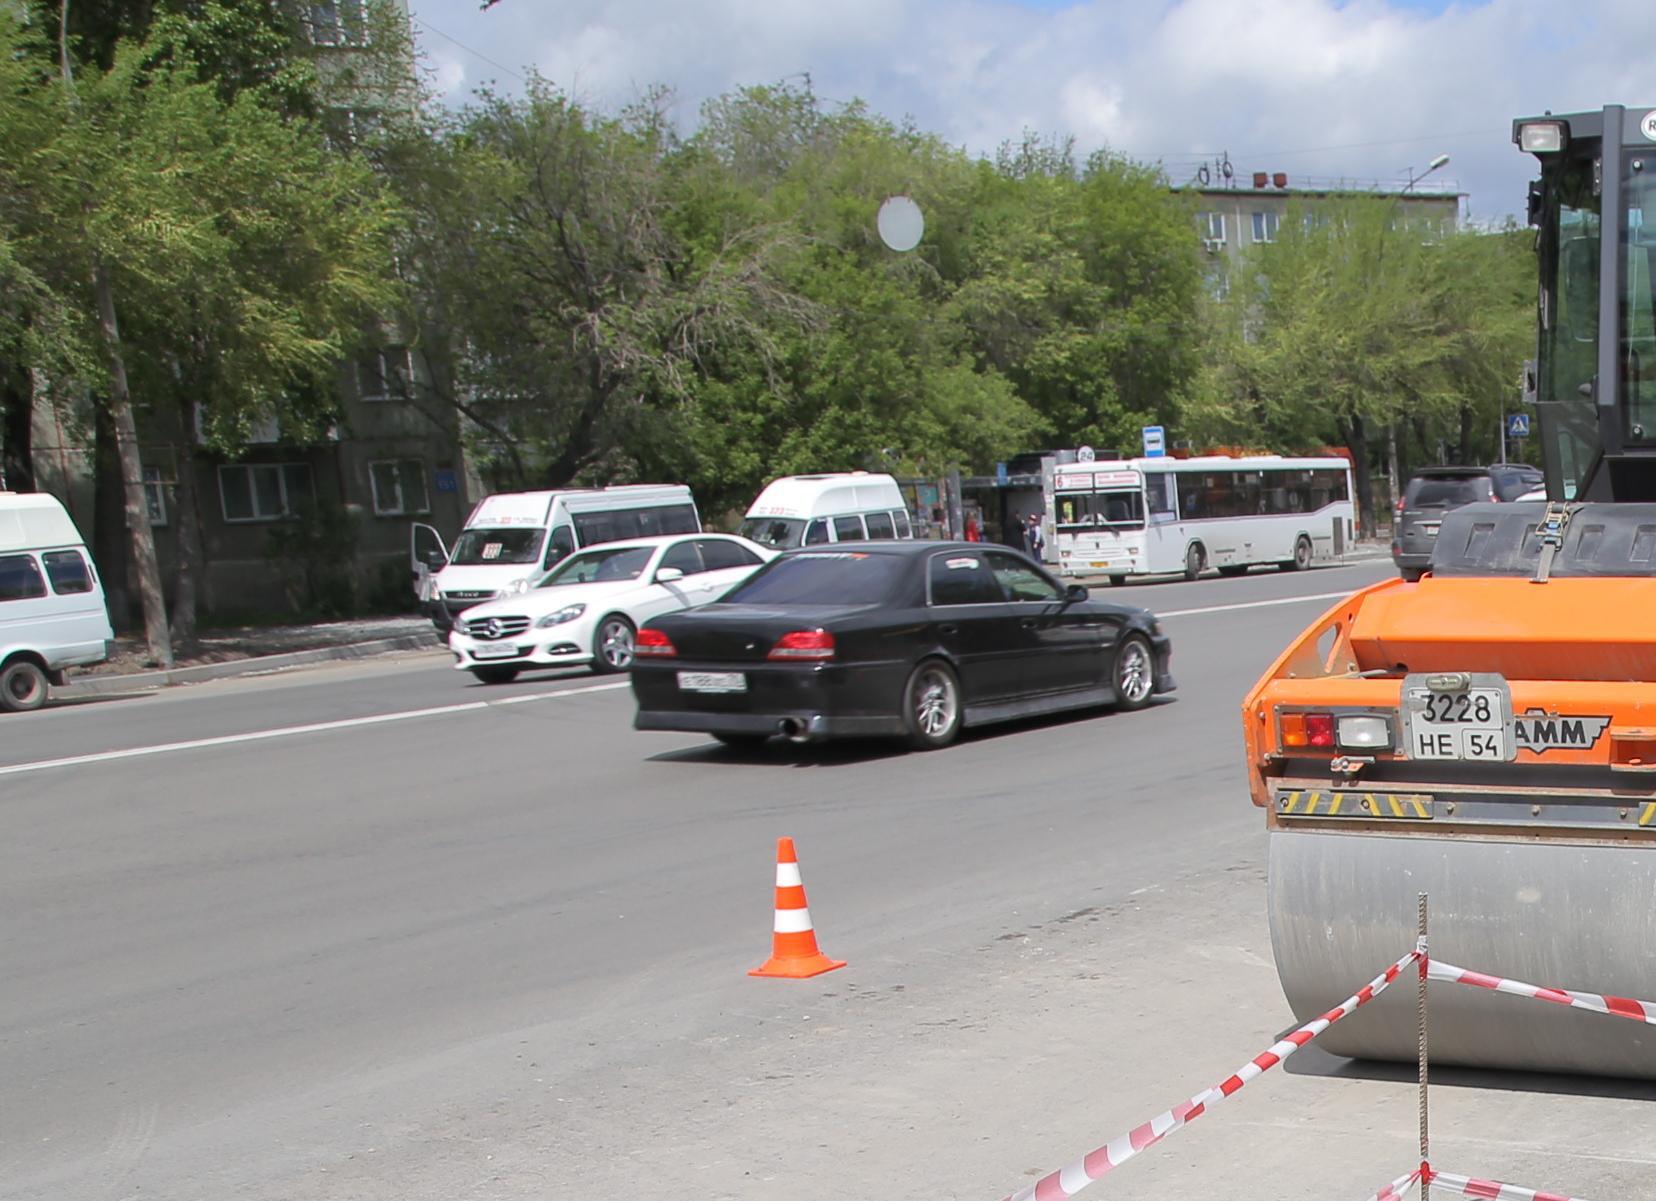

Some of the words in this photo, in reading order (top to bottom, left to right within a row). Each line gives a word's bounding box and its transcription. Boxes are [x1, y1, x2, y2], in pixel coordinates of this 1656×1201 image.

[1420, 694, 1492, 723] 3228
[1515, 719, 1586, 744] AMM
[1470, 734, 1498, 757] 54
